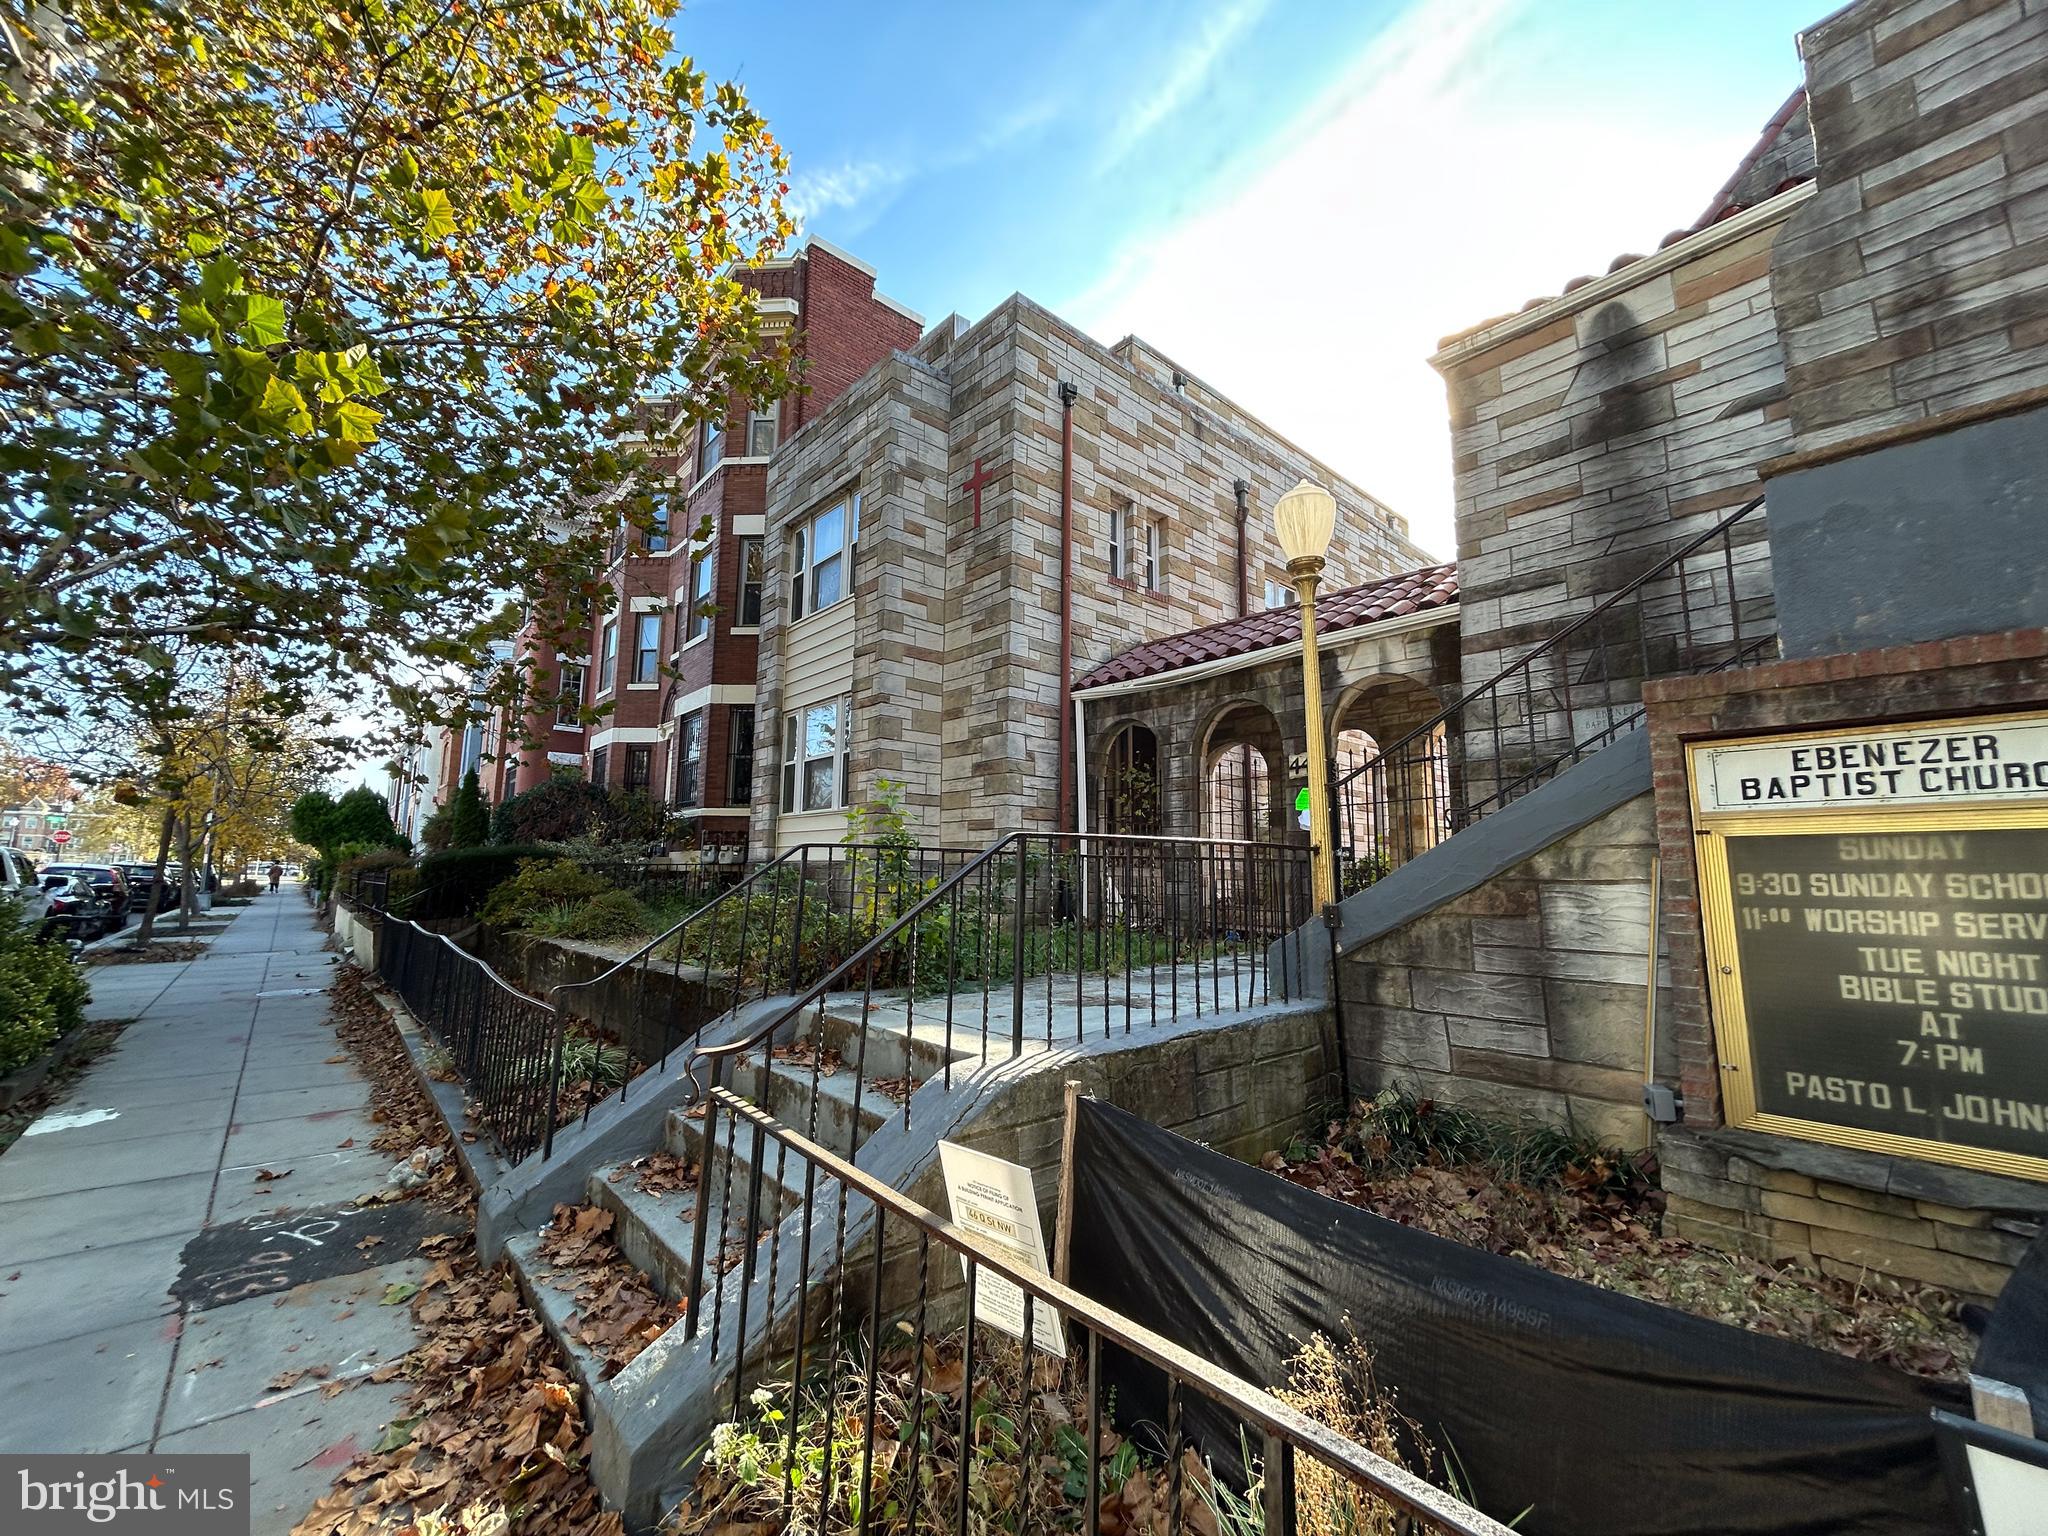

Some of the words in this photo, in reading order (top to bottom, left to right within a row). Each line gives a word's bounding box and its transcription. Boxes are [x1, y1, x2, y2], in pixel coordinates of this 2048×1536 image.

[1791, 734, 2000, 772] EBENEZER
[1740, 769, 1904, 801] BAPTIST
[1838, 835, 1969, 862] SUNDAY
[1735, 873, 1801, 897] 9:30
[1810, 873, 1933, 898] SUNDAY
[1945, 872, 2048, 900] SCHO
[1741, 907, 1791, 931] 11:00
[1804, 908, 1940, 937] WORSHIP
[1953, 911, 2048, 940] SERV
[1936, 950, 2041, 981] NIGHT
[1839, 974, 1939, 1006] BIBLE
[1920, 1011, 1963, 1040] AT
[1786, 1071, 1892, 1110] PASTO
[1943, 1093, 2048, 1133] JOHN
[968, 1208, 978, 1219] 46
[979, 1213, 985, 1222] Q
[987, 1216, 995, 1228] St
[997, 1220, 1011, 1233] NW
